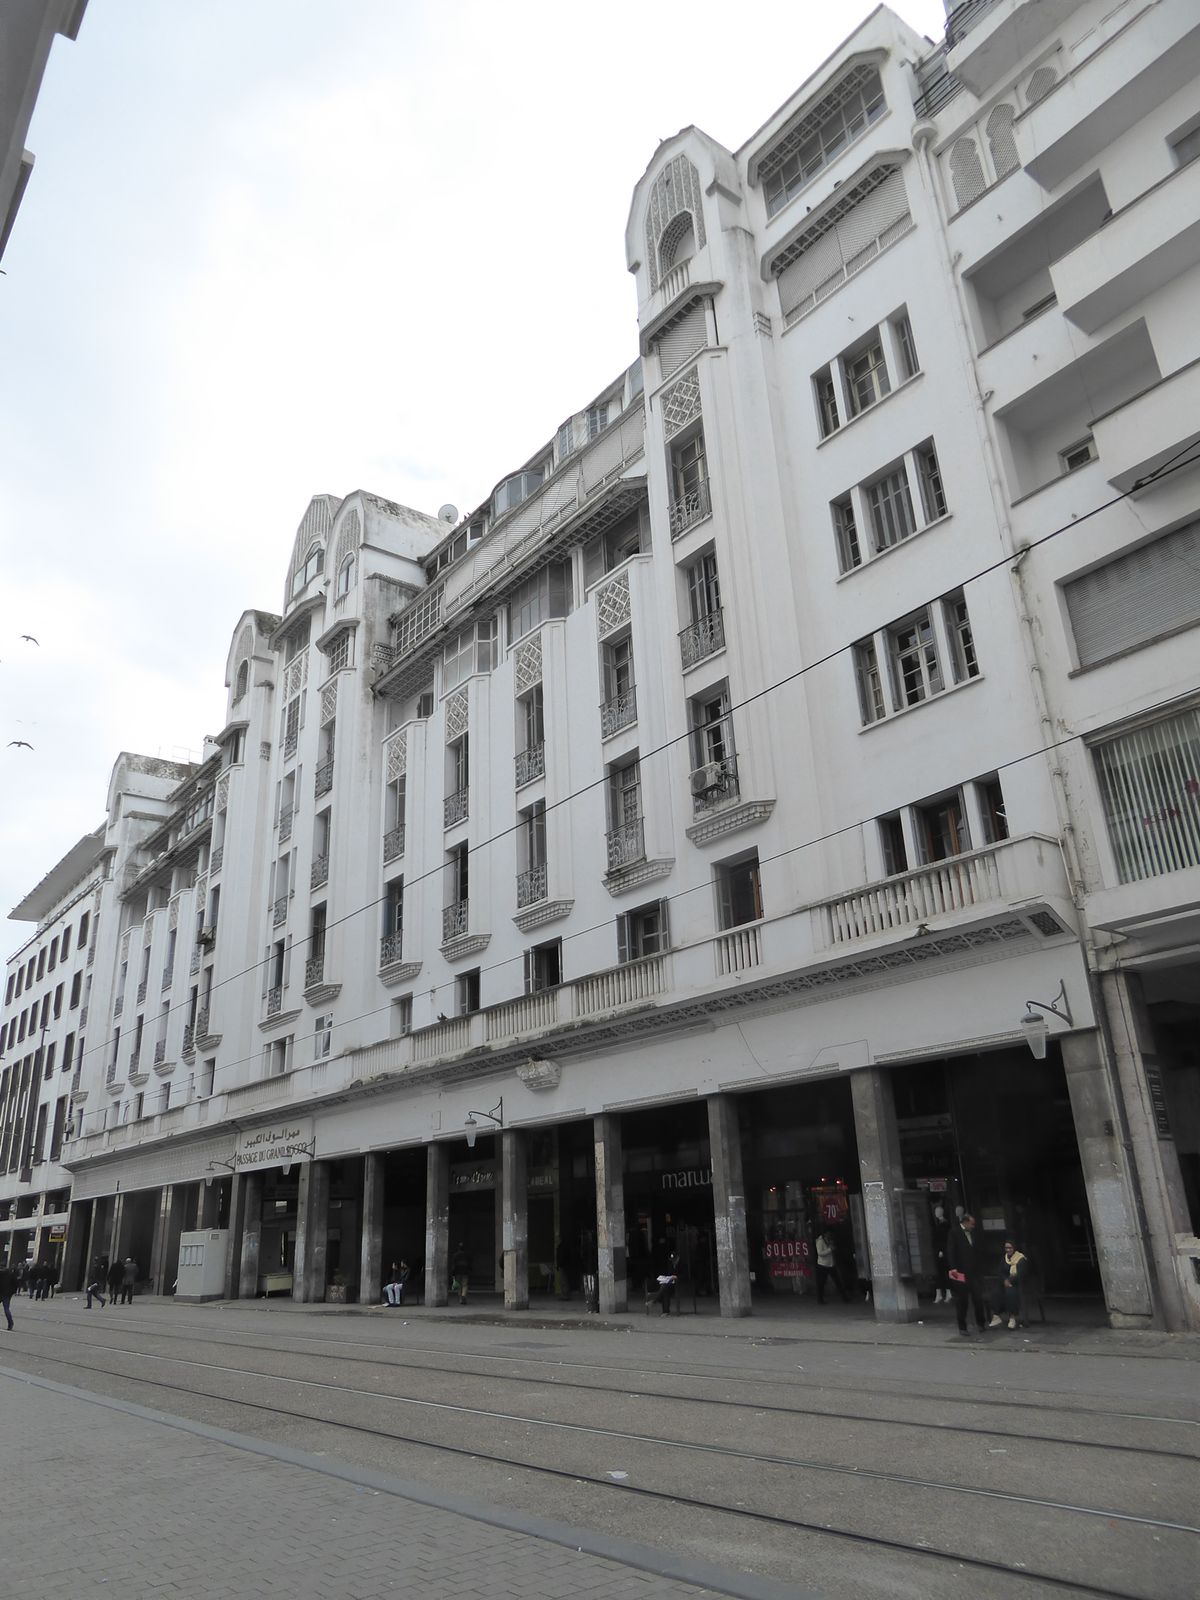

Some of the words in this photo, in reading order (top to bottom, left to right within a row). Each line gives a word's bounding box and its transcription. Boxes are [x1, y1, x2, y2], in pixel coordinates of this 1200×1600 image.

[244, 1133, 266, 1149] الكبير
[237, 1151, 259, 1166] PASSAGE
[258, 1149, 266, 1162] DU
[266, 1146, 286, 1160] GRAND
[662, 1169, 713, 1189] marw
[766, 1241, 809, 1257] SOLDES
